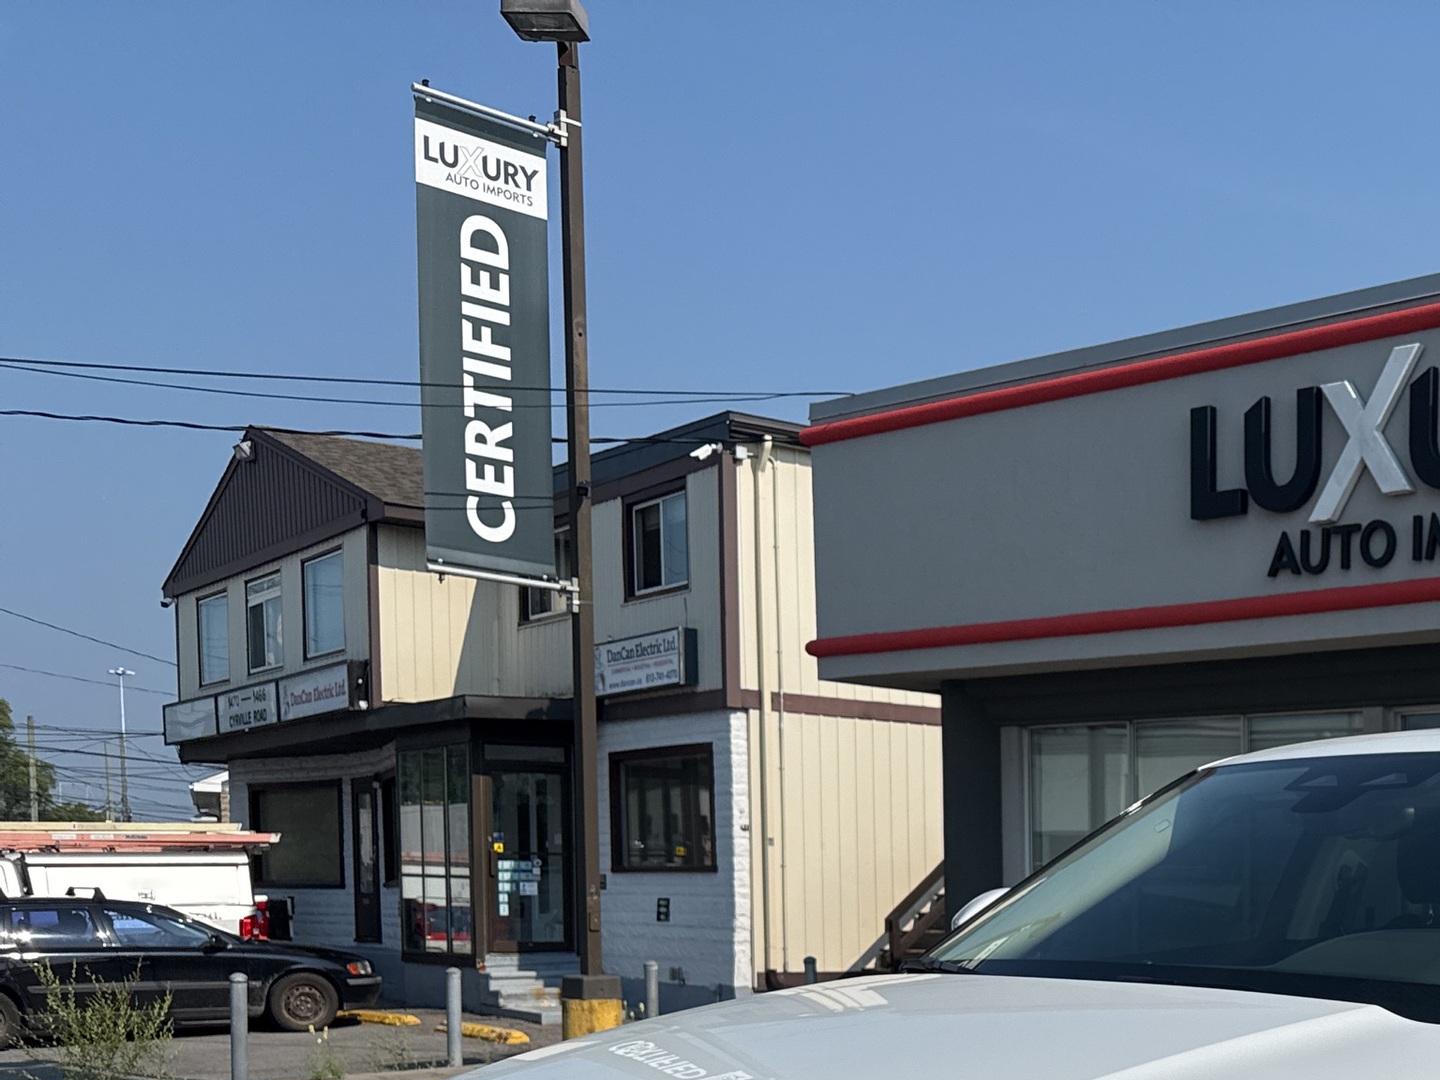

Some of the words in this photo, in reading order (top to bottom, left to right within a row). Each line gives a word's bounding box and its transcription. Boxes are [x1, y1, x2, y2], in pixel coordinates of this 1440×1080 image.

[423, 134, 539, 192] LUXURY
[446, 172, 479, 190] AUTO
[483, 183, 533, 207] IMPORTS
[460, 214, 516, 543] CERTIFIED
[1267, 520, 1397, 578] AUTO
[607, 646, 635, 663] DanCan
[635, 640, 662, 658] Electric
[253, 708, 267, 723] ROAD
